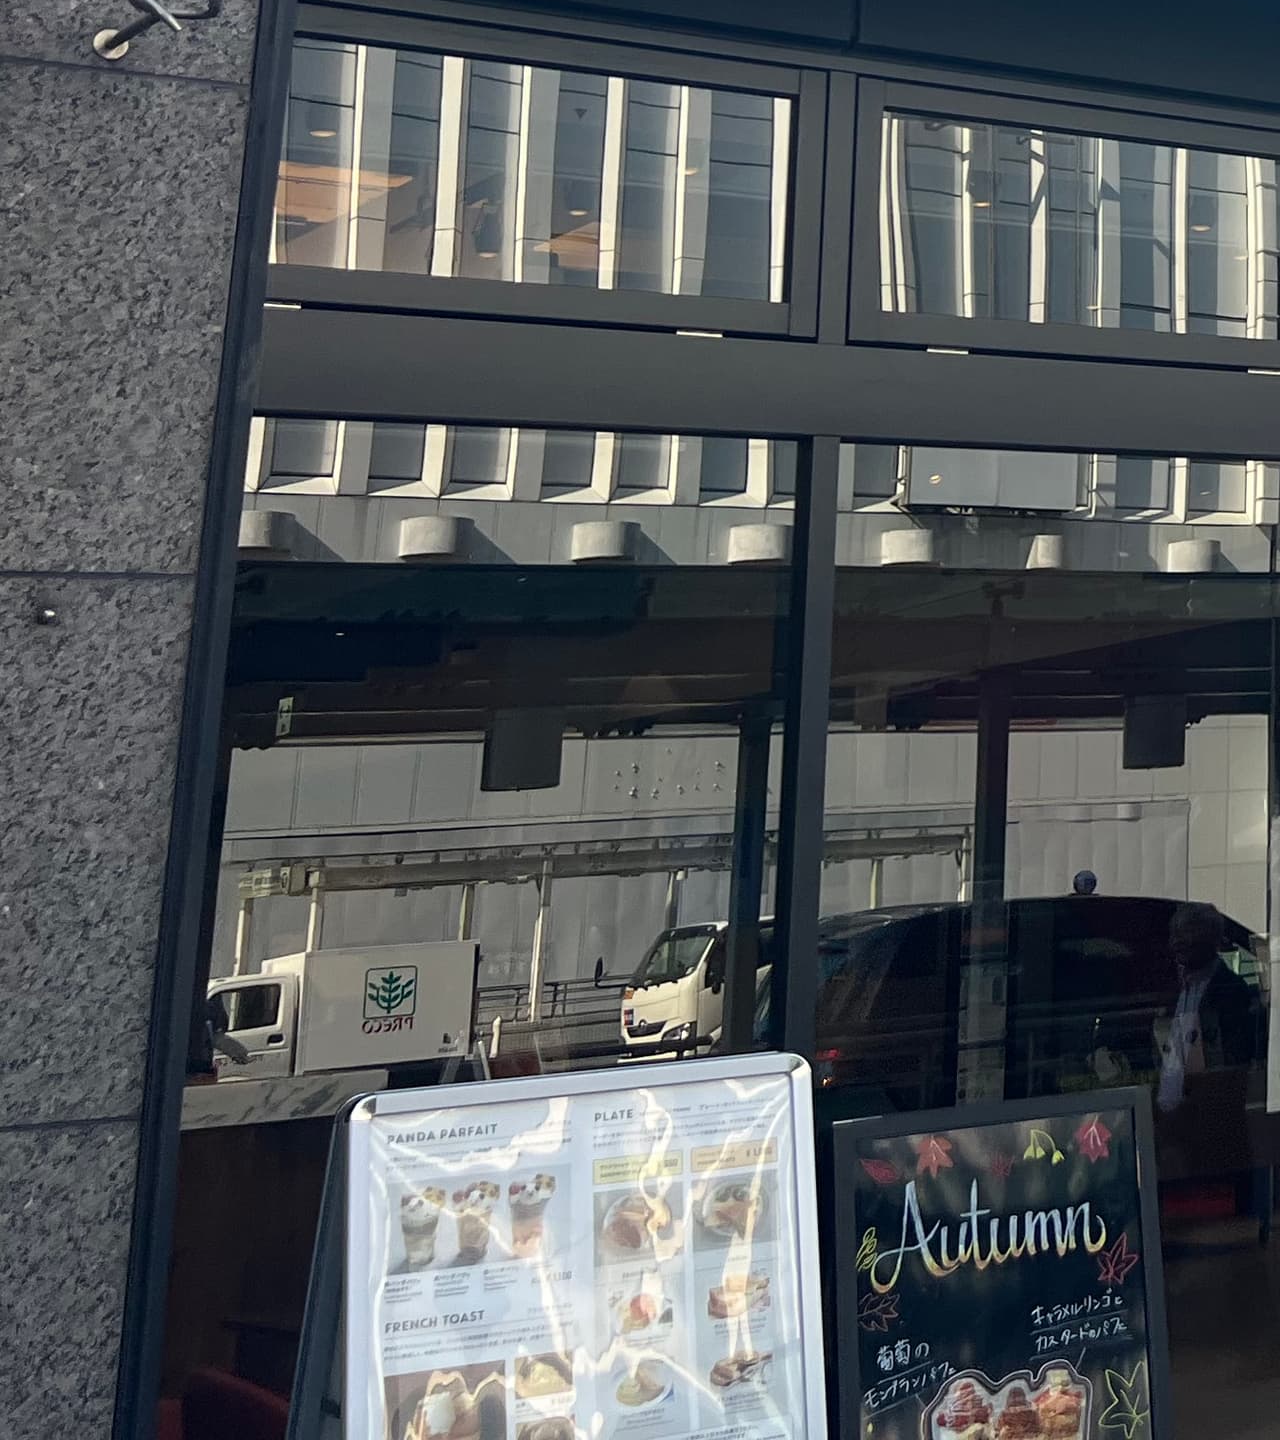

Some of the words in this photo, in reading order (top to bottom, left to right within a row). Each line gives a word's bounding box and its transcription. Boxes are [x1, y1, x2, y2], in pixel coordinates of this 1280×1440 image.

[594, 1108, 634, 1123] PLATE
[387, 1129, 436, 1145] PANDA
[440, 1123, 498, 1139] PARFAIT
[870, 1177, 1106, 1294] Autumn
[384, 1315, 437, 1333] FRENCH
[442, 1309, 485, 1326] TOAST
